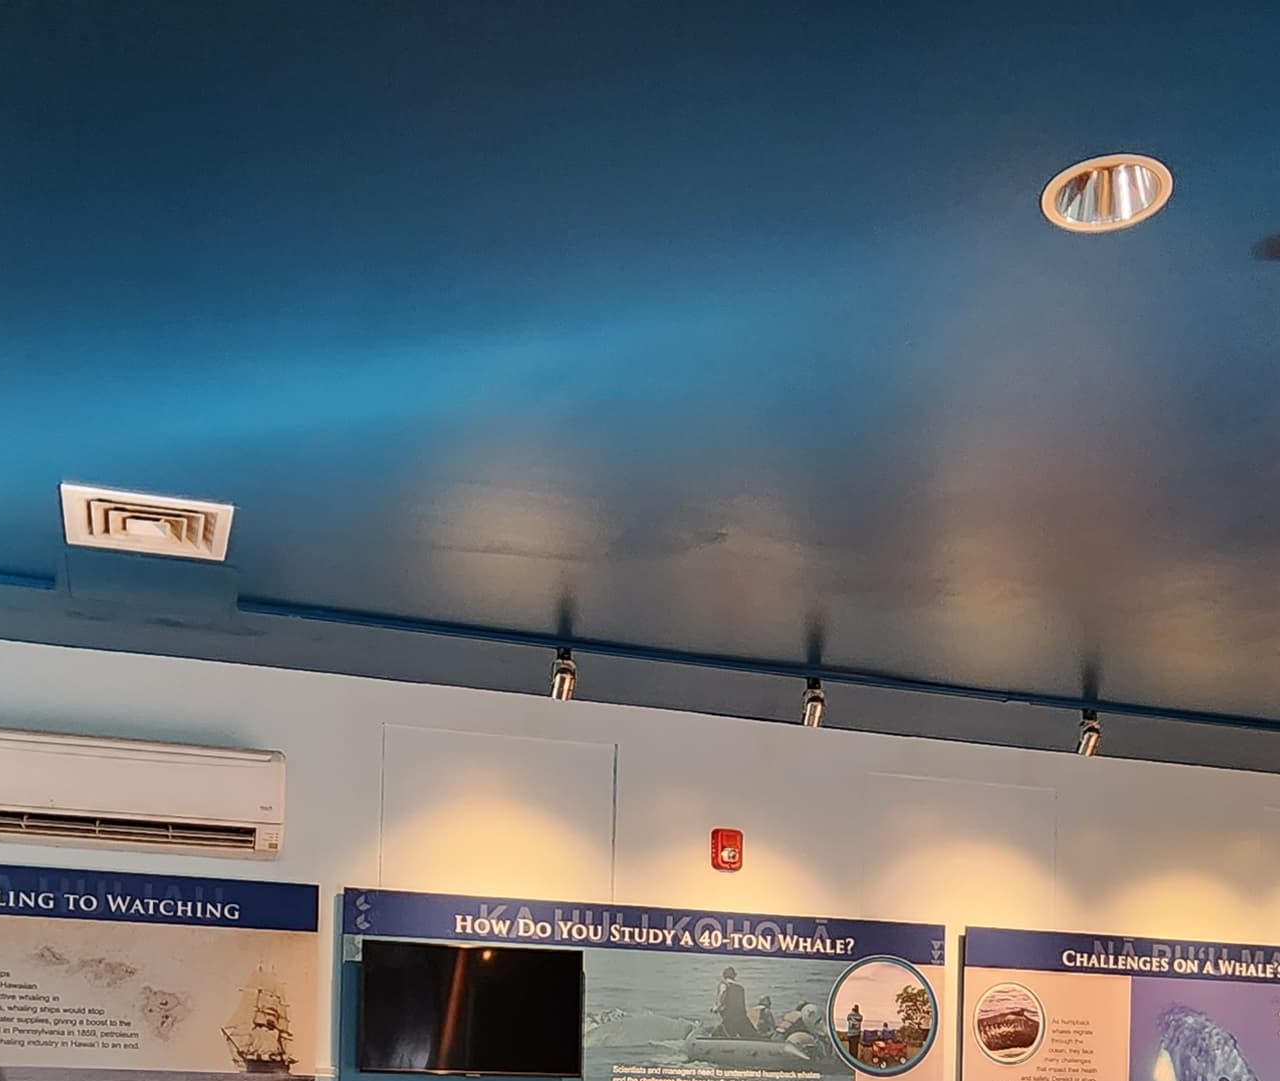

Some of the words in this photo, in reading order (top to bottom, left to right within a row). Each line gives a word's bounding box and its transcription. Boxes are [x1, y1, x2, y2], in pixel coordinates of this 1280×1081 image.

[64, 894, 98, 911] TO
[107, 894, 240, 920] WATCHING
[455, 914, 510, 937] HOW
[519, 919, 551, 938] DO
[558, 921, 602, 941] YOU
[610, 924, 676, 944] STUDY
[681, 931, 693, 946] A
[699, 929, 772, 950] 40-TON
[778, 934, 855, 954] WHALE?
[1062, 950, 1169, 972] CHALLENGES
[1174, 959, 1198, 974] ON
[1203, 962, 1214, 974] A
[0, 980, 37, 989] Hawaiian
[19, 992, 49, 1002] whaling
[52, 993, 59, 1001] in
[7, 1003, 37, 1014] whaling
[40, 1005, 60, 1015] ships
[63, 1005, 85, 1014] would
[88, 1006, 104, 1017] stop
[13, 1026, 65, 1037] Pennsylvania
[67, 1028, 74, 1036] in
[100, 1029, 139, 1040] petroleum
[613, 1066, 646, 1074] Scientists
[648, 1066, 660, 1074] and
[662, 1069, 696, 1077] managers
[698, 1068, 714, 1076] need
[724, 1068, 761, 1077] understand
[763, 1069, 796, 1080] humpback
